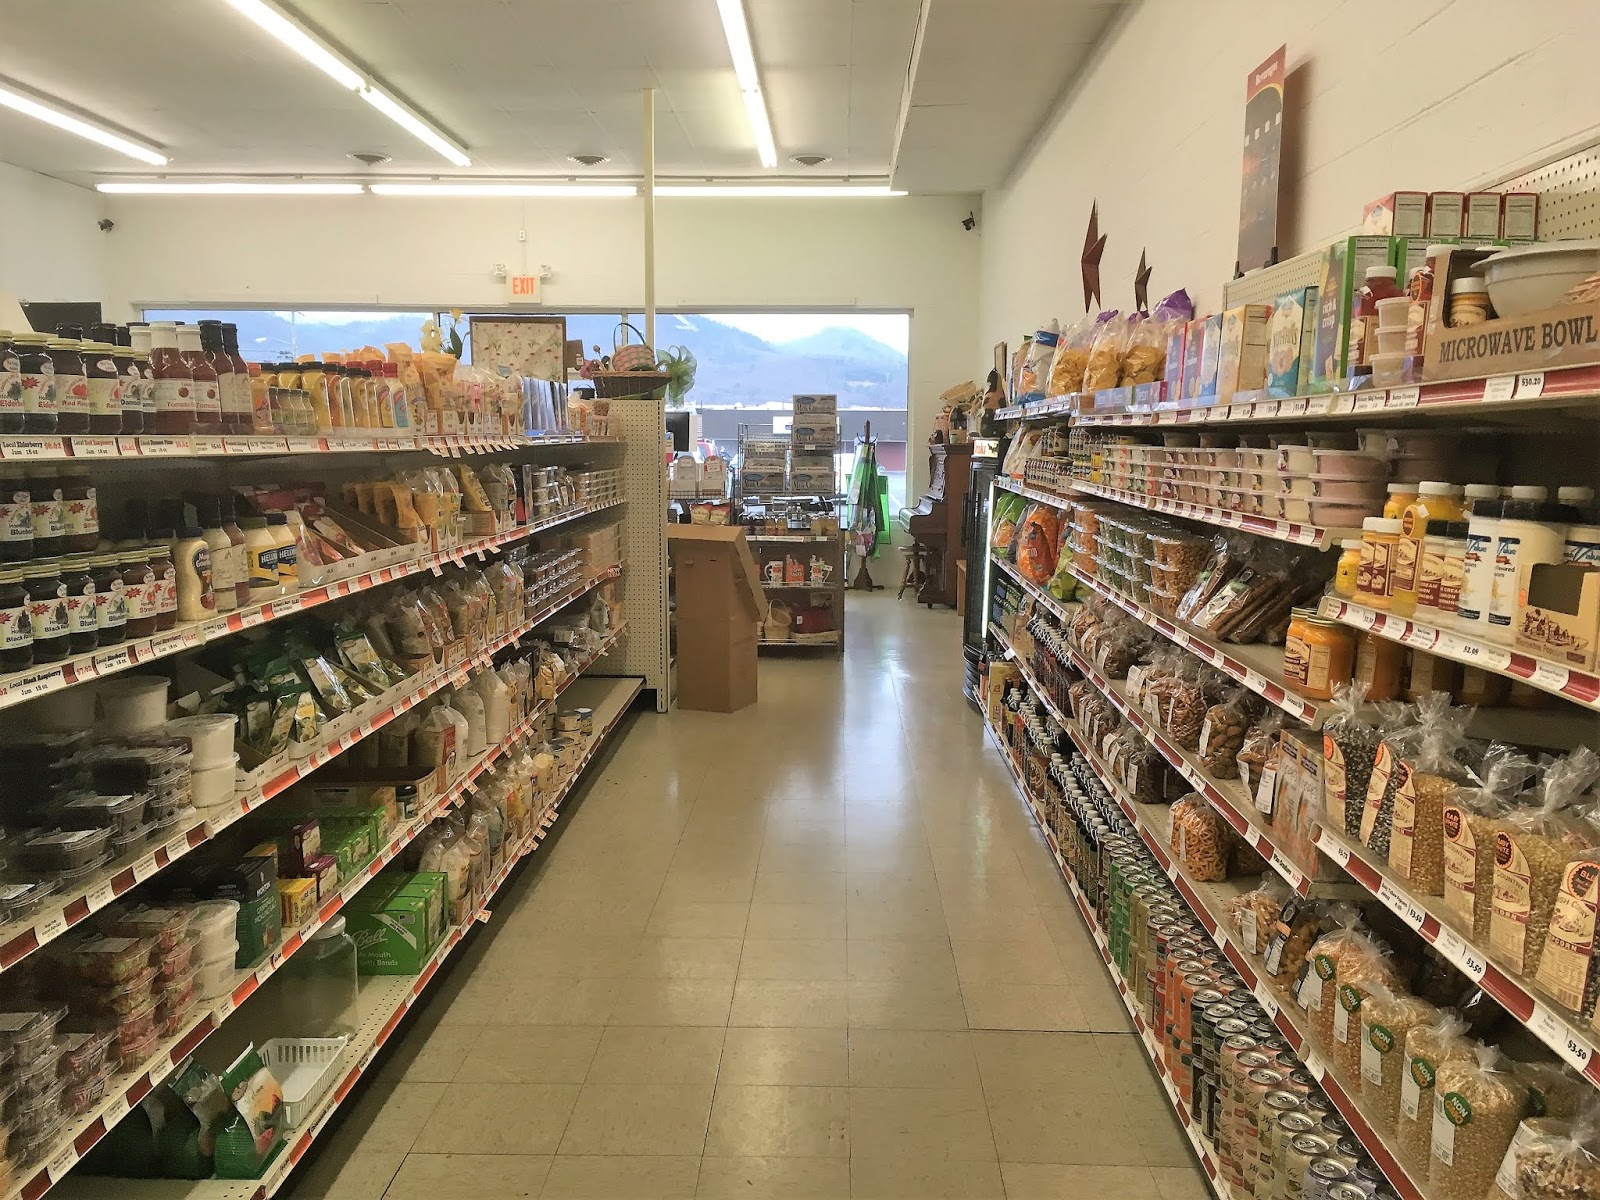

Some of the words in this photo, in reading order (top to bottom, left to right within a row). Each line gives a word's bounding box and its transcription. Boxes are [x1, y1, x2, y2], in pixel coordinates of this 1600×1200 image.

[512, 277, 535, 294] EXIT
[1439, 326, 1535, 364] MICROWAVE
[1541, 316, 1598, 349] BOWL
[9, 681, 23, 689] Local
[1496, 869, 1524, 890] COUNTRY
[352, 928, 388, 949] Ball
[1320, 958, 1333, 975] NON
[1466, 957, 1482, 974] $3.50
[1345, 989, 1358, 1006] NON
[1374, 1028, 1391, 1044] NON
[1567, 1040, 1587, 1060] $3.50
[1417, 1062, 1433, 1082] NON
[1451, 1096, 1469, 1118] NON
